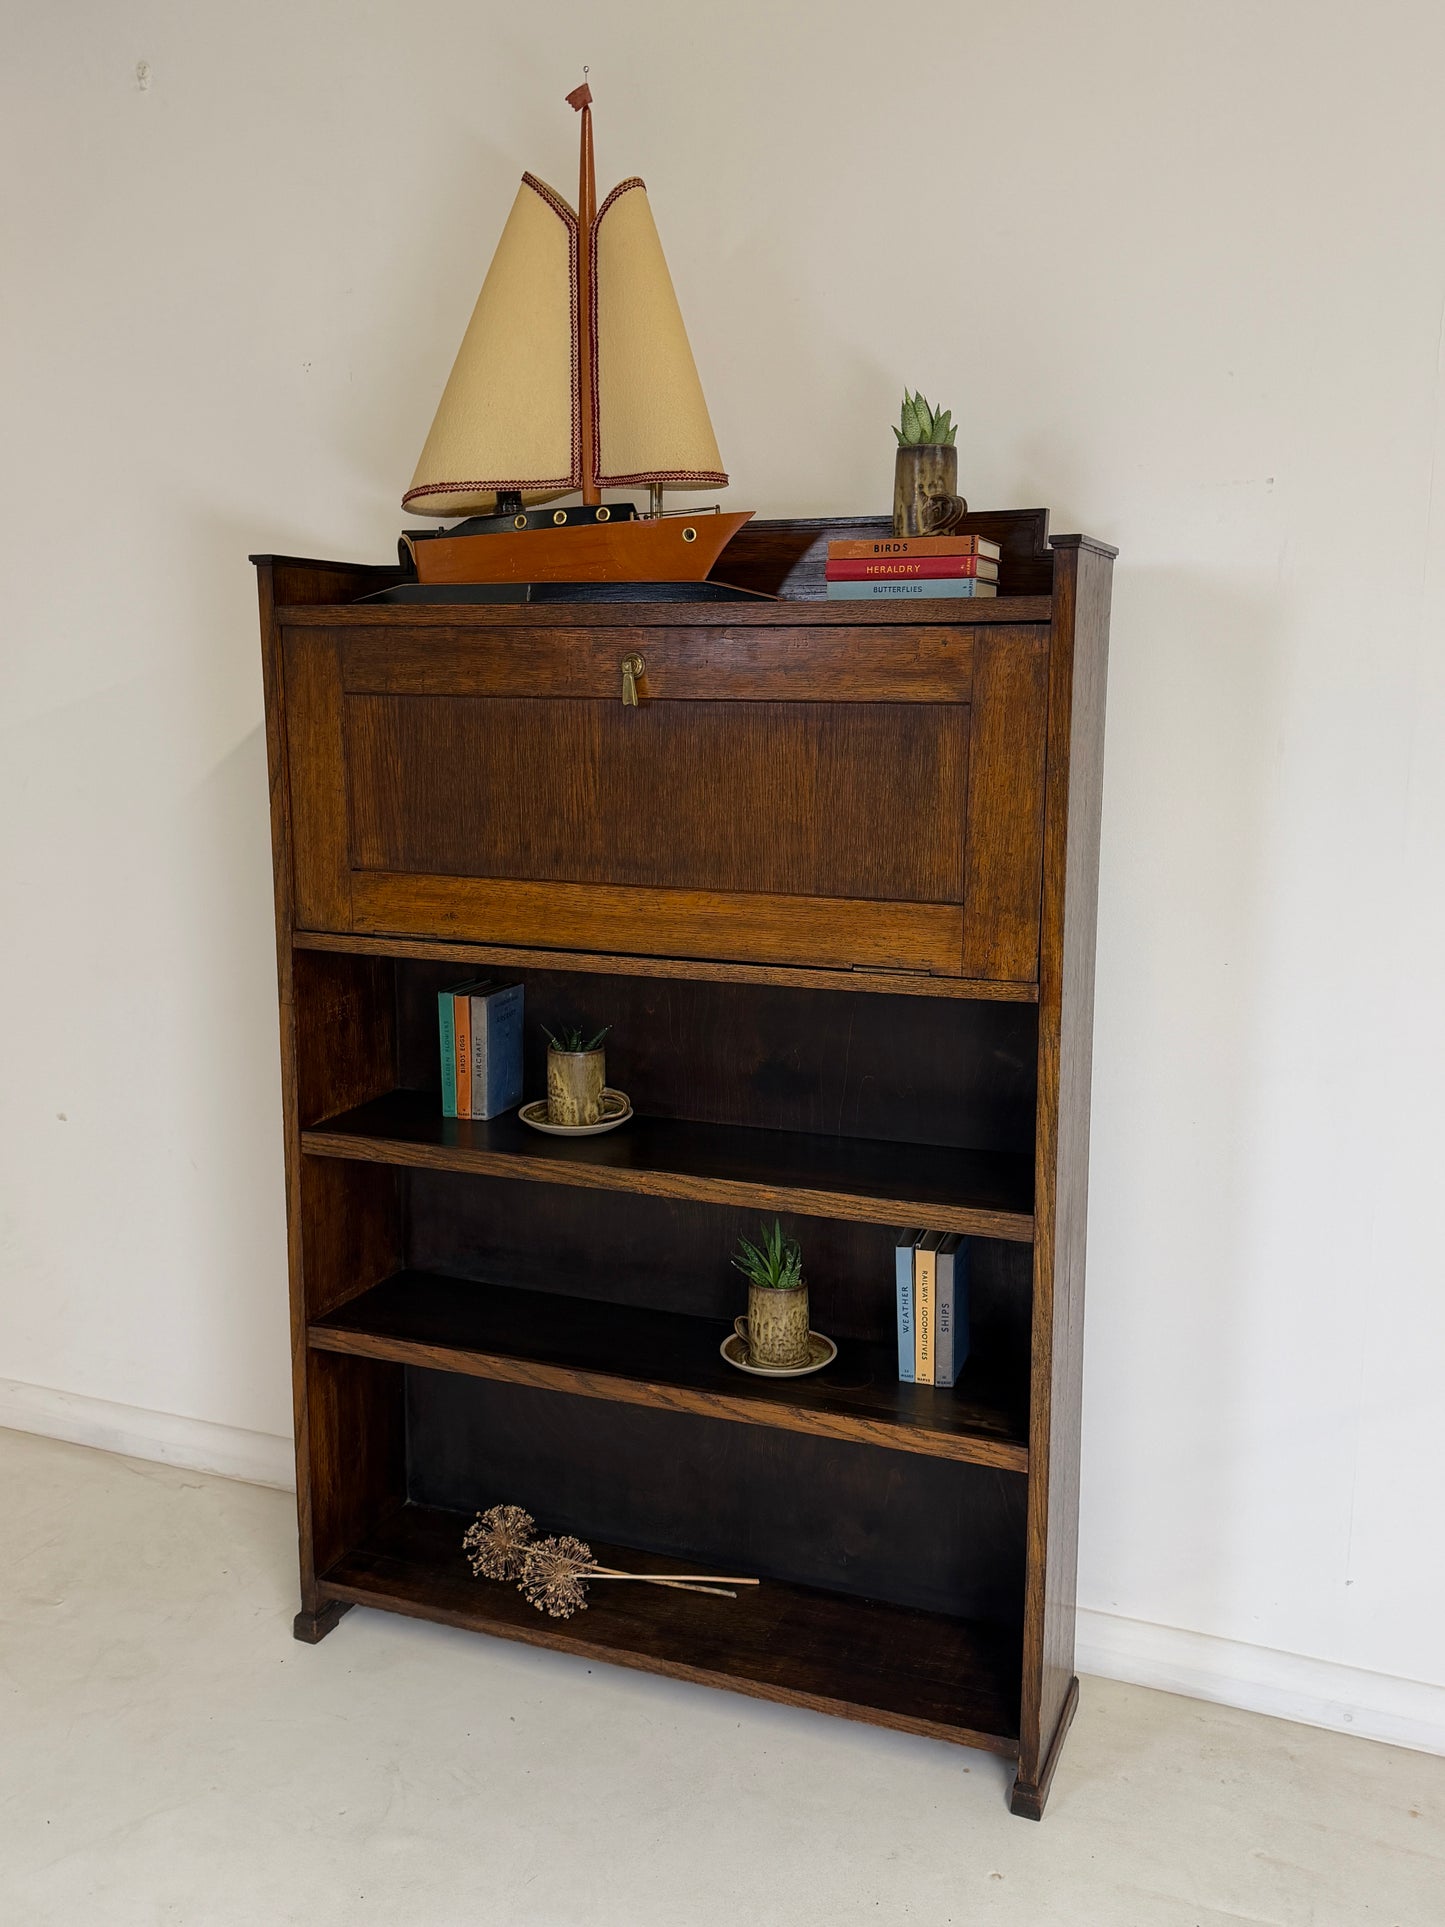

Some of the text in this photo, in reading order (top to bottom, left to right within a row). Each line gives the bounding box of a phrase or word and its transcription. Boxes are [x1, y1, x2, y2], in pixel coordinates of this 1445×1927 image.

[873, 543, 908, 553] BIRDS
[866, 564, 921, 574] HERALDRY
[873, 585, 923, 593] BUTTERFLIES
[901, 1286, 909, 1334] WEATHER
[941, 1303, 949, 1333] SHIPS
